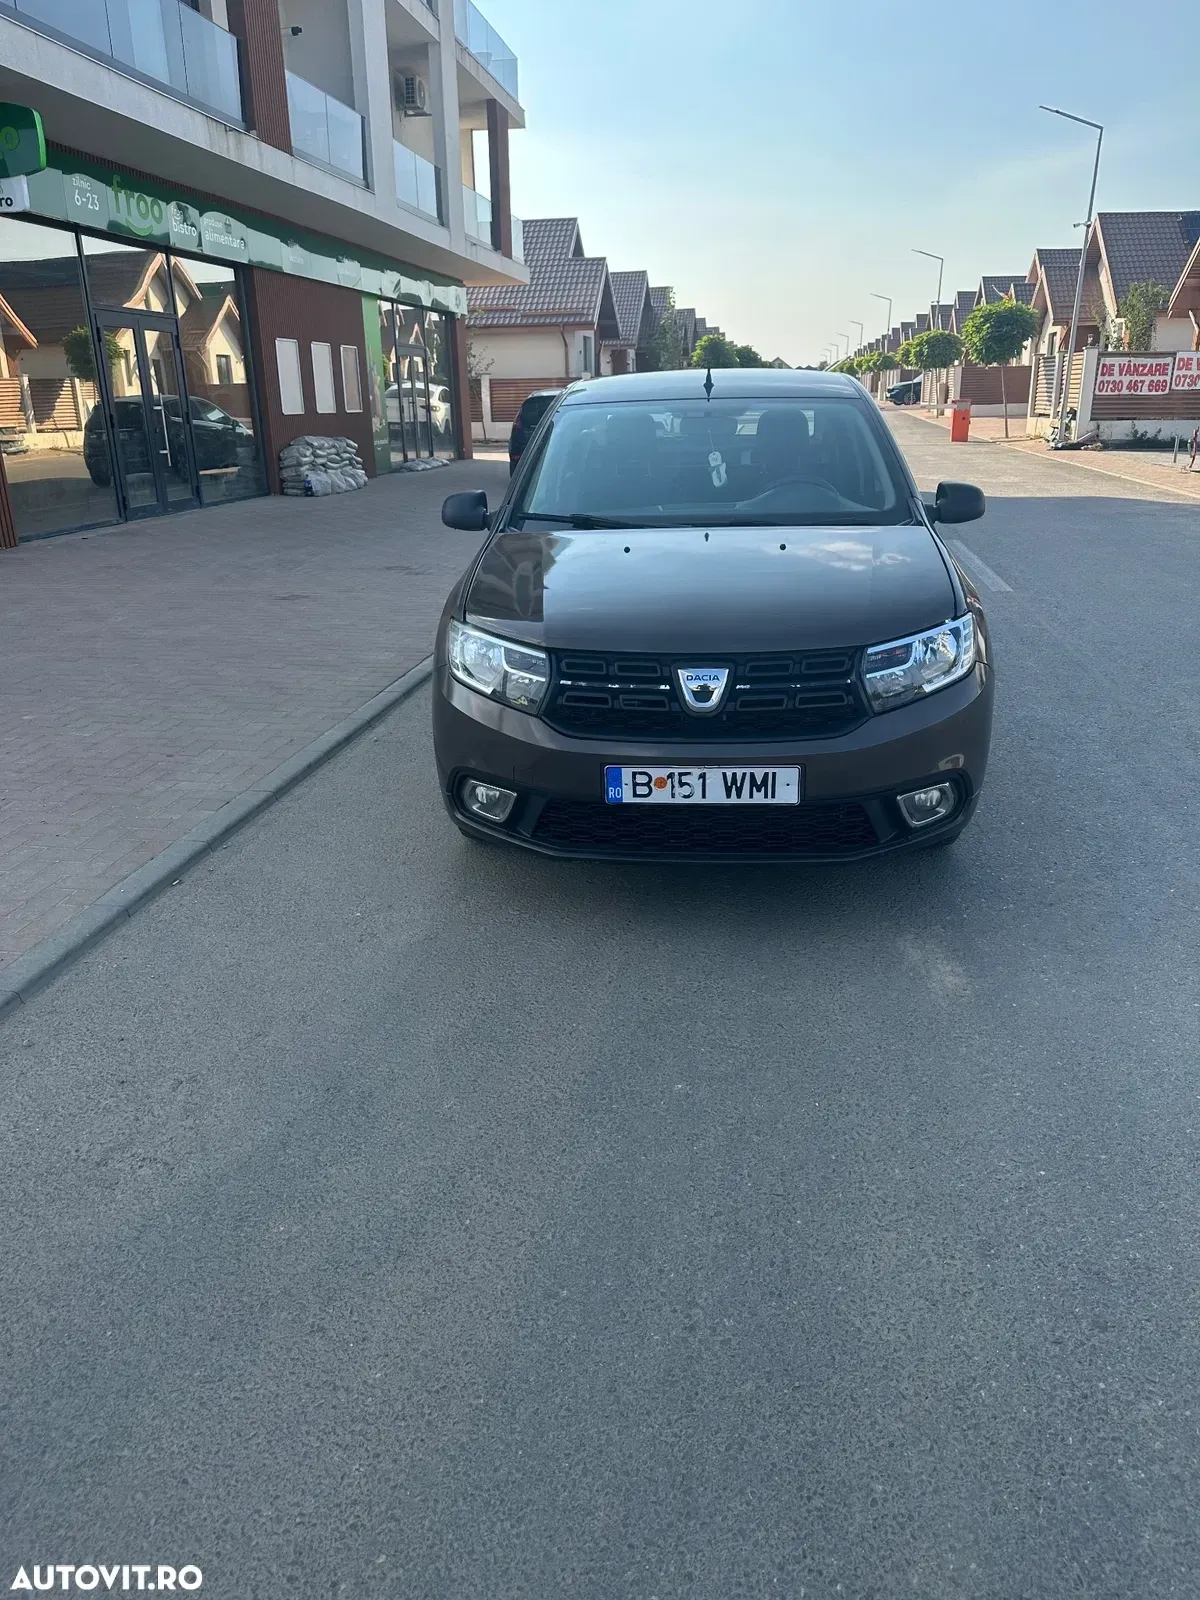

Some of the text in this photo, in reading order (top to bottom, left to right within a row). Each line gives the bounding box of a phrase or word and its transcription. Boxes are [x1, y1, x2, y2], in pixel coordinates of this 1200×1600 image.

[74, 189, 99, 211] 6-23
[111, 174, 163, 224] froo
[172, 220, 197, 237] bistro
[204, 227, 245, 250] alimentare
[1100, 360, 1170, 376] DE VÂNZARE
[1177, 357, 1193, 371] DE
[1098, 379, 1168, 393] 0730 467 669
[686, 674, 720, 682] DACIA
[608, 787, 622, 799] RO
[631, 771, 777, 799] B 151 WMI
